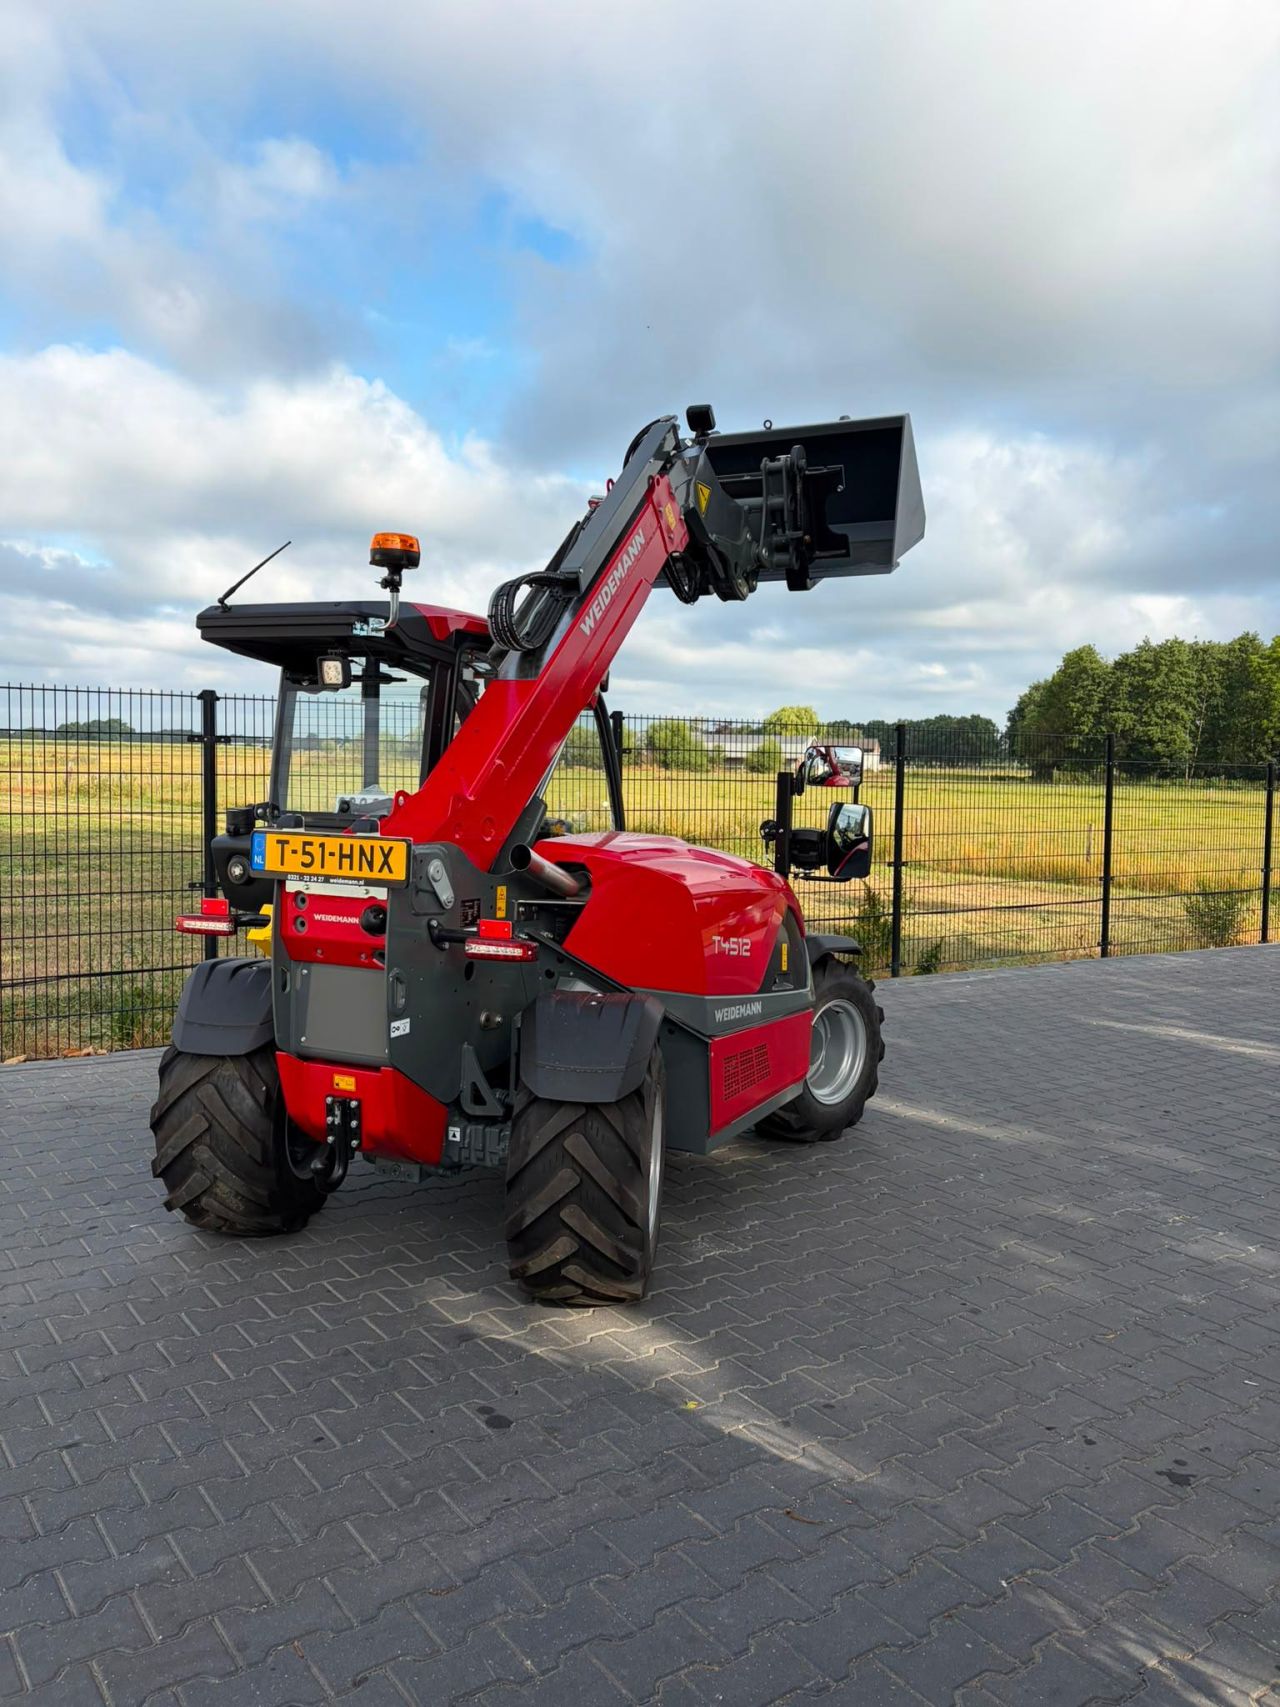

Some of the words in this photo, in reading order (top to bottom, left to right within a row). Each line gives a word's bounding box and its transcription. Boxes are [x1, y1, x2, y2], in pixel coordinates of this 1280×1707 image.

[580, 527, 646, 636] WEIDEMANN
[254, 855, 264, 864] NL
[275, 838, 394, 874] T-51-HNX
[329, 877, 365, 885] weidemann.nl
[313, 913, 360, 924] WEIDEMANN
[712, 936, 751, 956] T4512
[715, 1001, 762, 1022] WEIDEMANN
